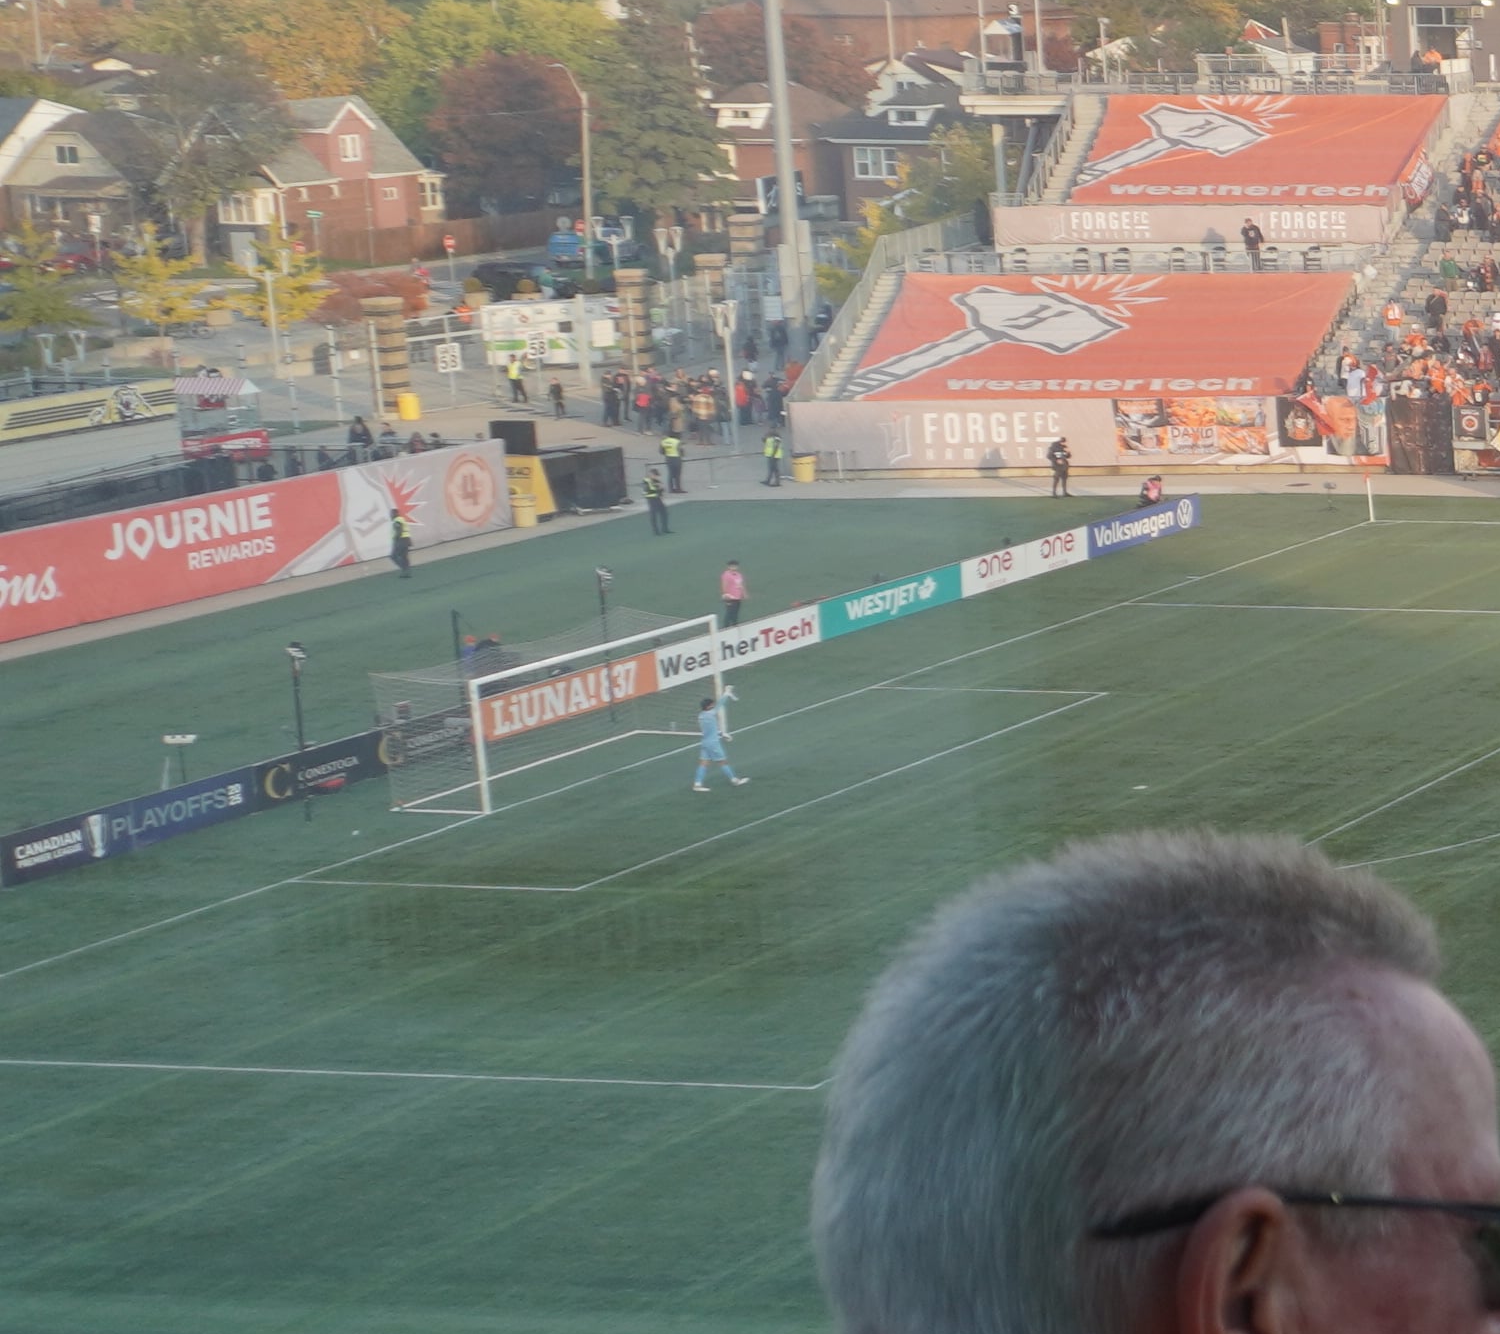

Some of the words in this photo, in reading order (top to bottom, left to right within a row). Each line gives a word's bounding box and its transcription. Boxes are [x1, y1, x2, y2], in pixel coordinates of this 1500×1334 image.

[1254, 78, 1276, 90] 111
[1110, 184, 1390, 197] WeatherTech
[1070, 211, 1131, 230] FORGE
[1269, 210, 1328, 229] FORGE
[947, 377, 1254, 392] WeatherTech
[923, 410, 1031, 443] FORGE
[1034, 410, 1060, 433] FC
[105, 493, 272, 561] JOURNIE
[1094, 510, 1174, 548] Volkswagen
[188, 534, 276, 572] REWARDS
[1040, 531, 1075, 560] one
[977, 550, 1014, 579] one
[845, 581, 919, 621] WESTJET
[660, 617, 814, 679] WeaherTech
[490, 670, 596, 737] LiUNA!
[112, 787, 228, 841] PLAYOFFS
[15, 829, 82, 861] CANADIAN
[17, 848, 51, 868] PREMIER
[52, 842, 83, 862] LEAGUE
